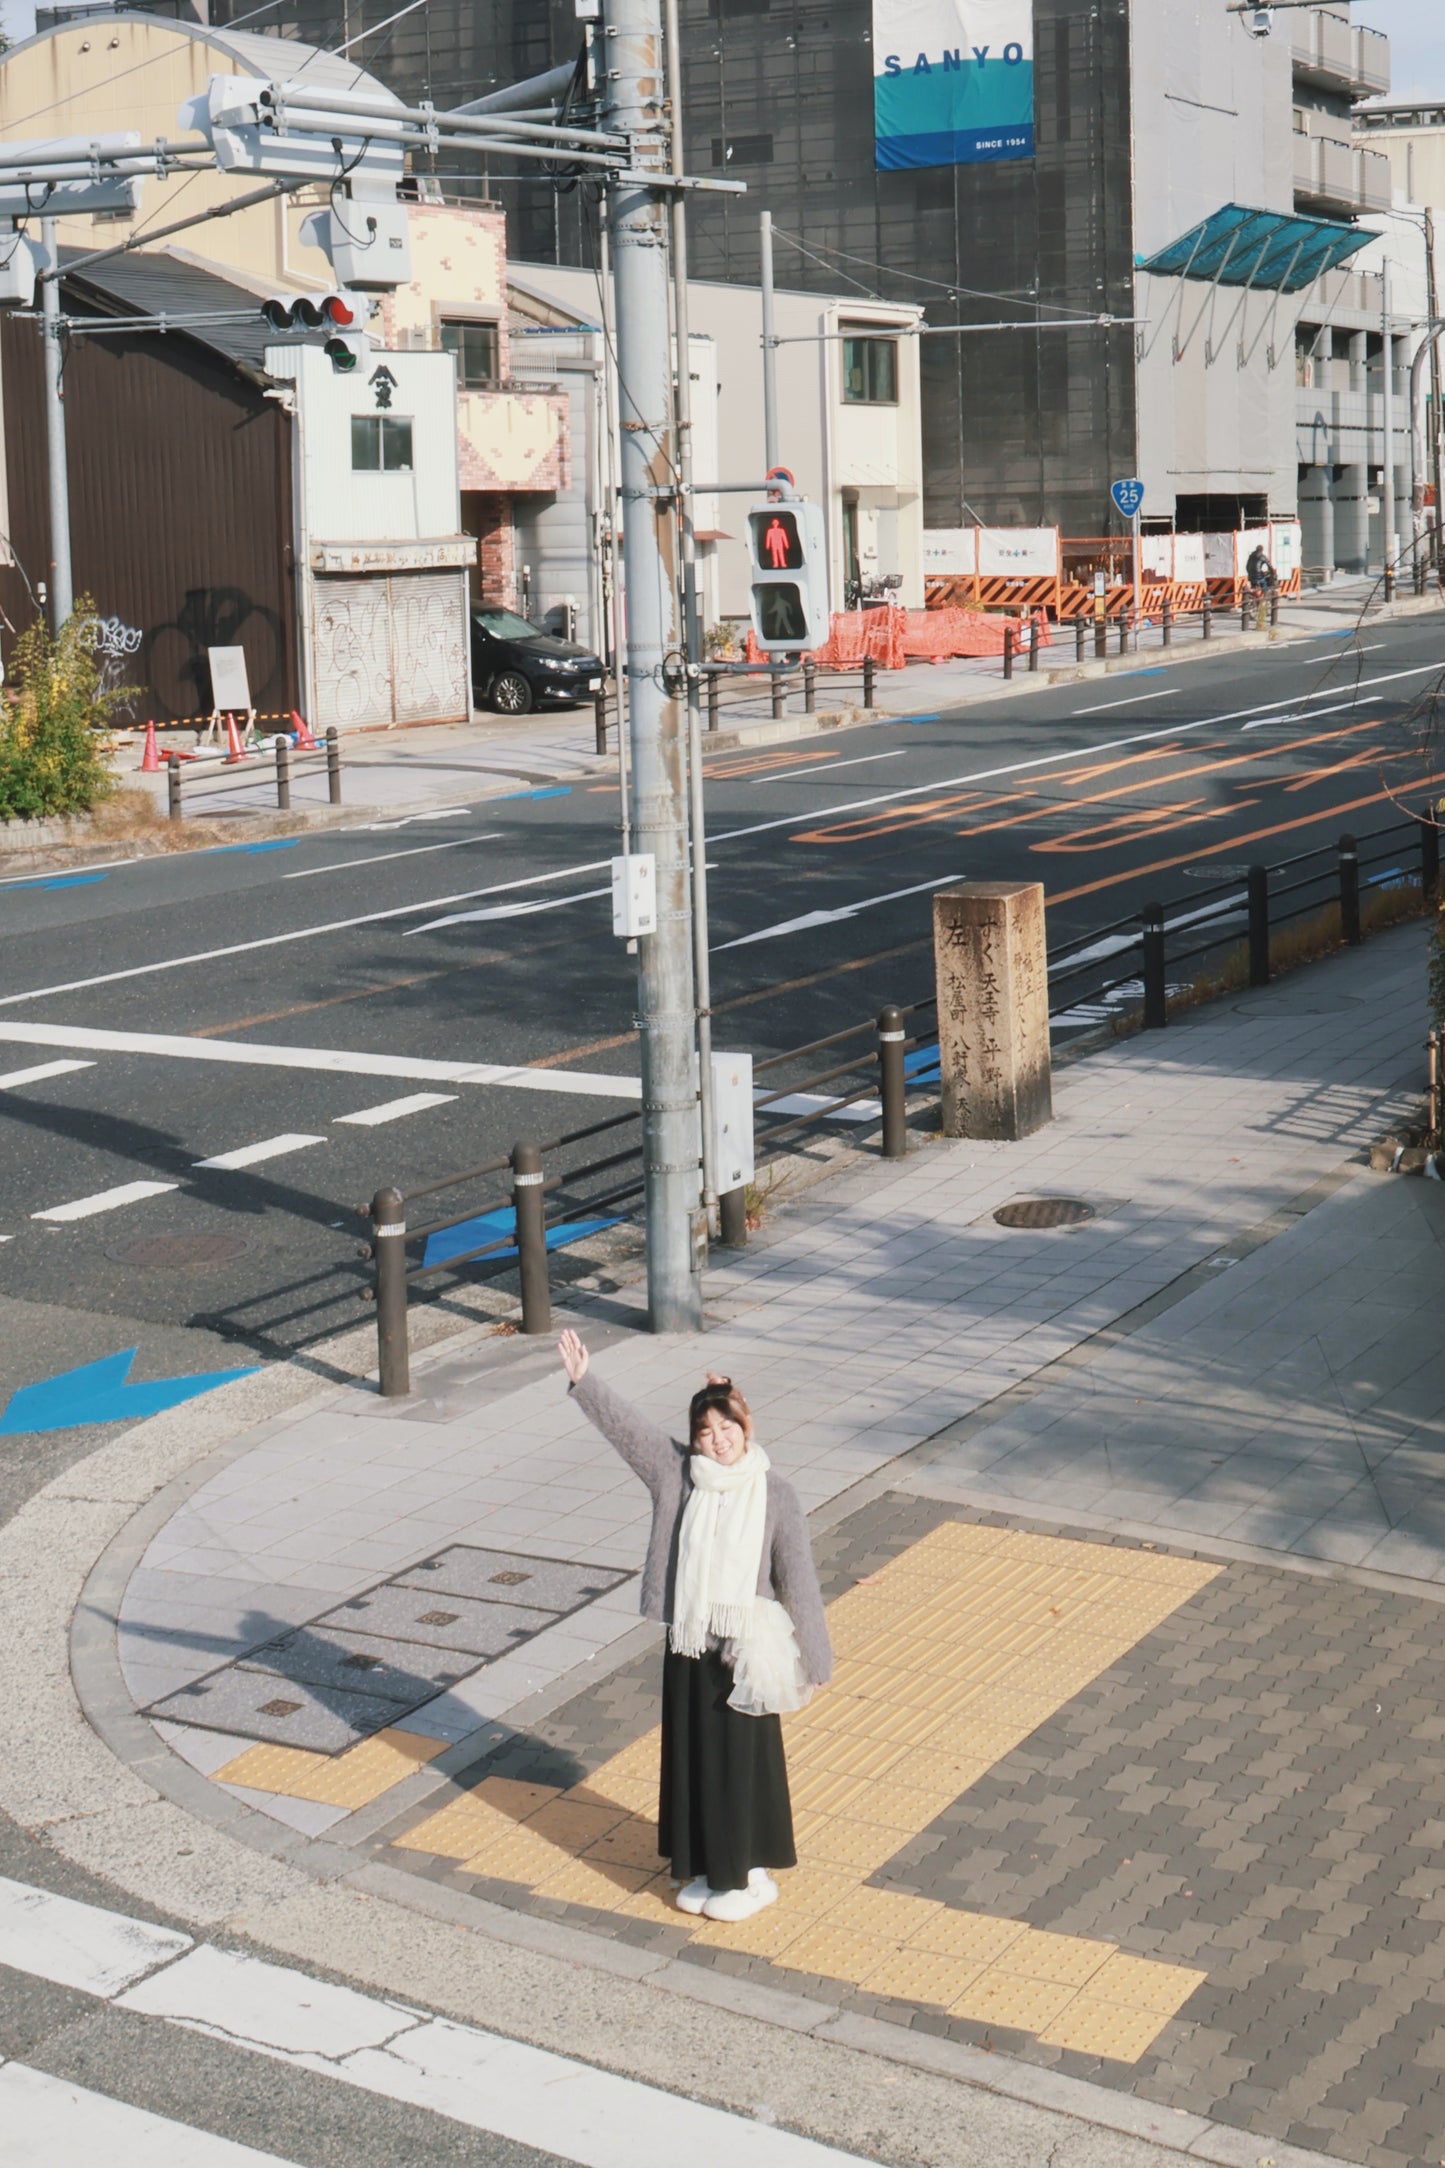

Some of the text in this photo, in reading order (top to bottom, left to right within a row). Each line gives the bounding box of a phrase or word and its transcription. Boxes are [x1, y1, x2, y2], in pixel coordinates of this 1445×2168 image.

[884, 42, 1024, 78] SANYO
[975, 138, 1026, 149] SINCE 1954
[1119, 488, 1139, 504] 25
